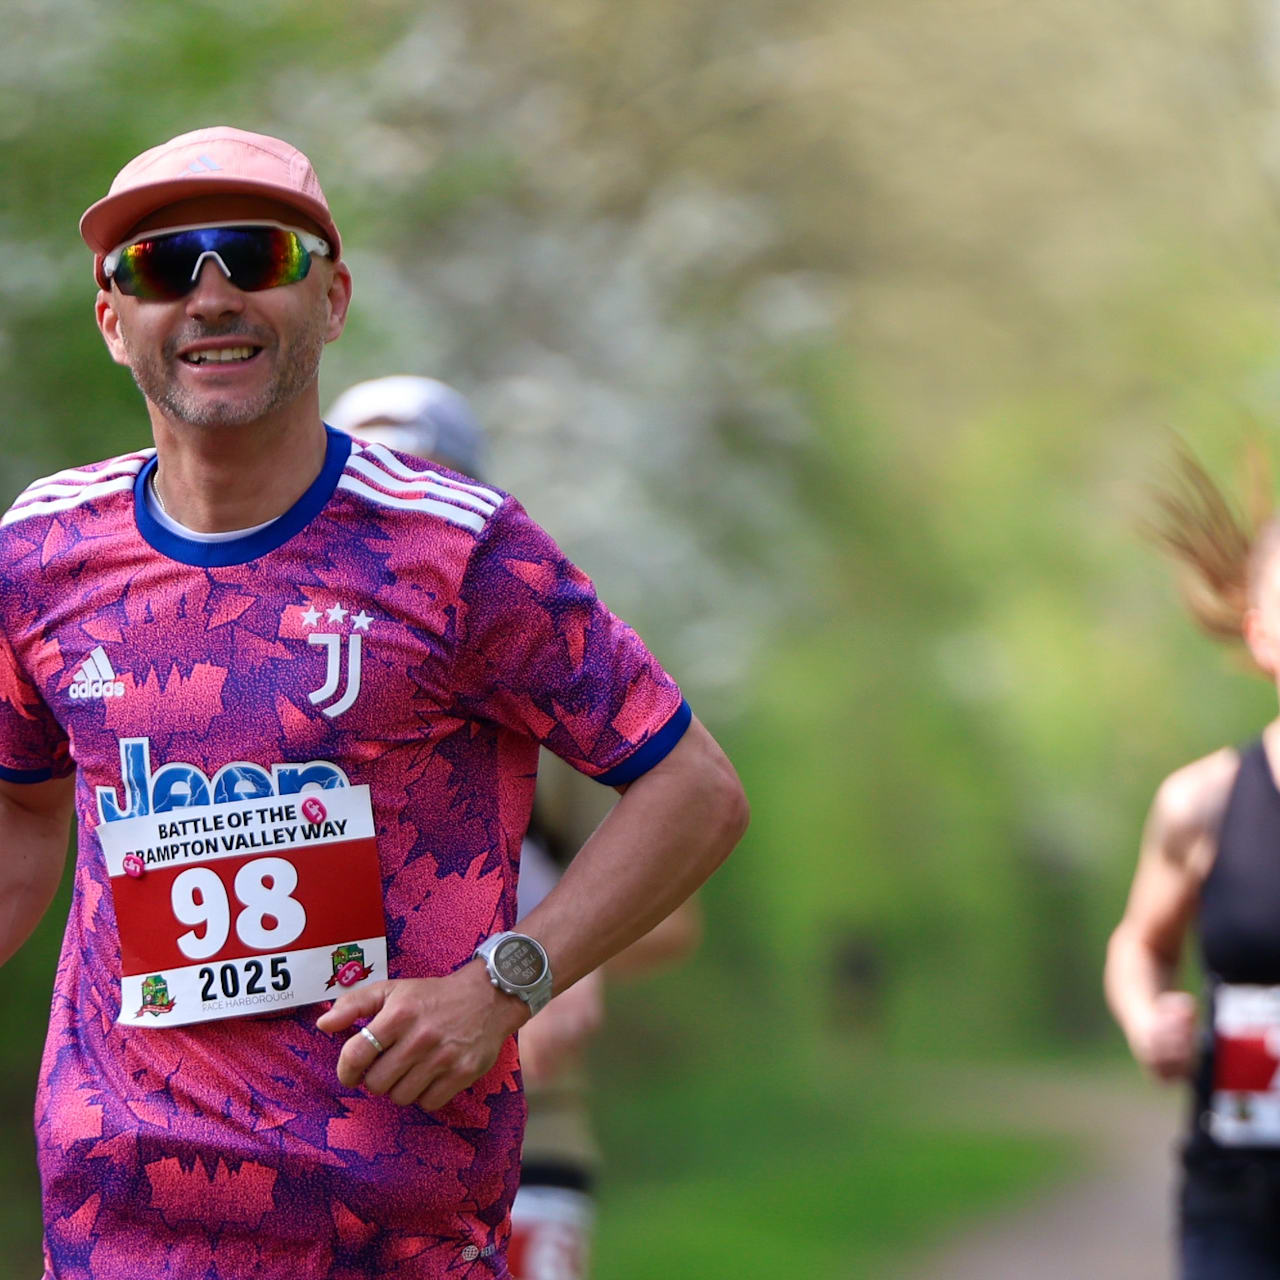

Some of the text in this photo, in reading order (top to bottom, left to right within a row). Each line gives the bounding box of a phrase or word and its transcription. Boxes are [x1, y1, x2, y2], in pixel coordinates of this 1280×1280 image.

[69, 679, 125, 698] adidas
[126, 819, 348, 864] RAMPTON VALLEY WAY
[158, 804, 297, 839] BATTLE OF THE
[170, 857, 307, 959] 98
[199, 956, 292, 1002] 2025
